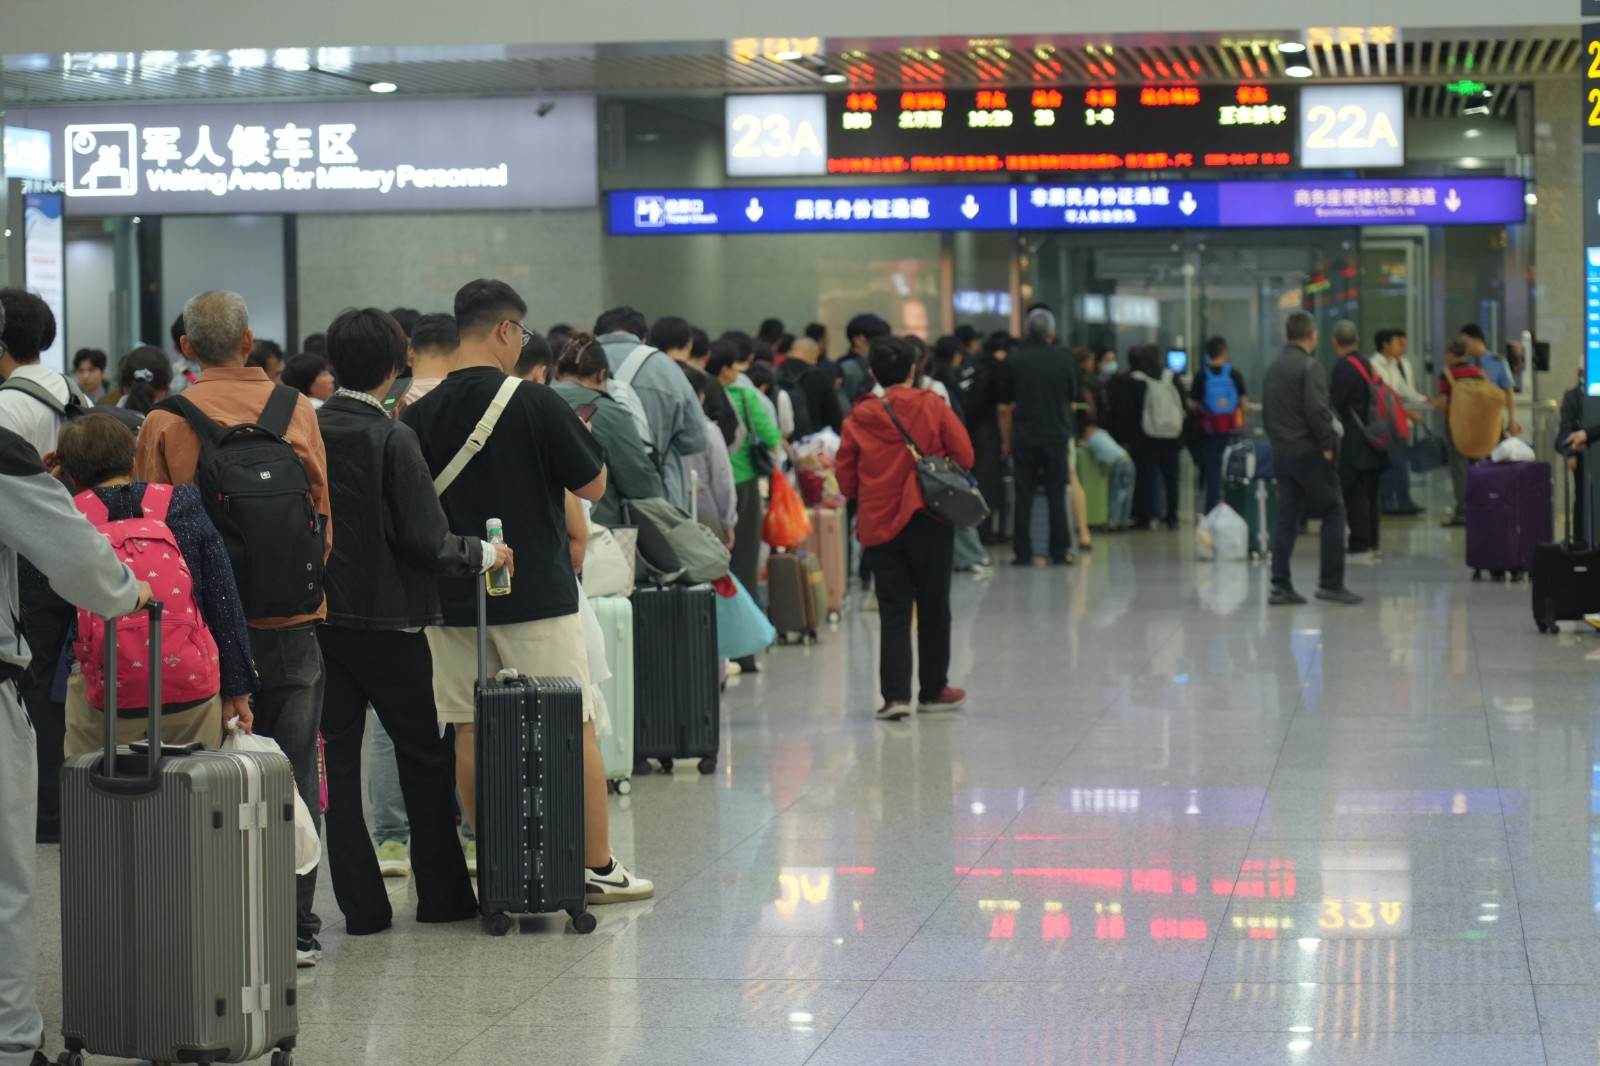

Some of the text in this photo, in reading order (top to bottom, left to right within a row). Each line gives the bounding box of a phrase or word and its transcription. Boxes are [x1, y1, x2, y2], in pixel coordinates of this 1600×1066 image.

[141, 122, 358, 167] 军人候车区
[732, 114, 822, 158] 23A
[1306, 105, 1399, 149] 22A
[146, 163, 508, 195] Waiting Area for Military Personnel
[1030, 186, 1170, 207] 非居民身份证通道
[794, 197, 931, 220] 居民身份证通道
